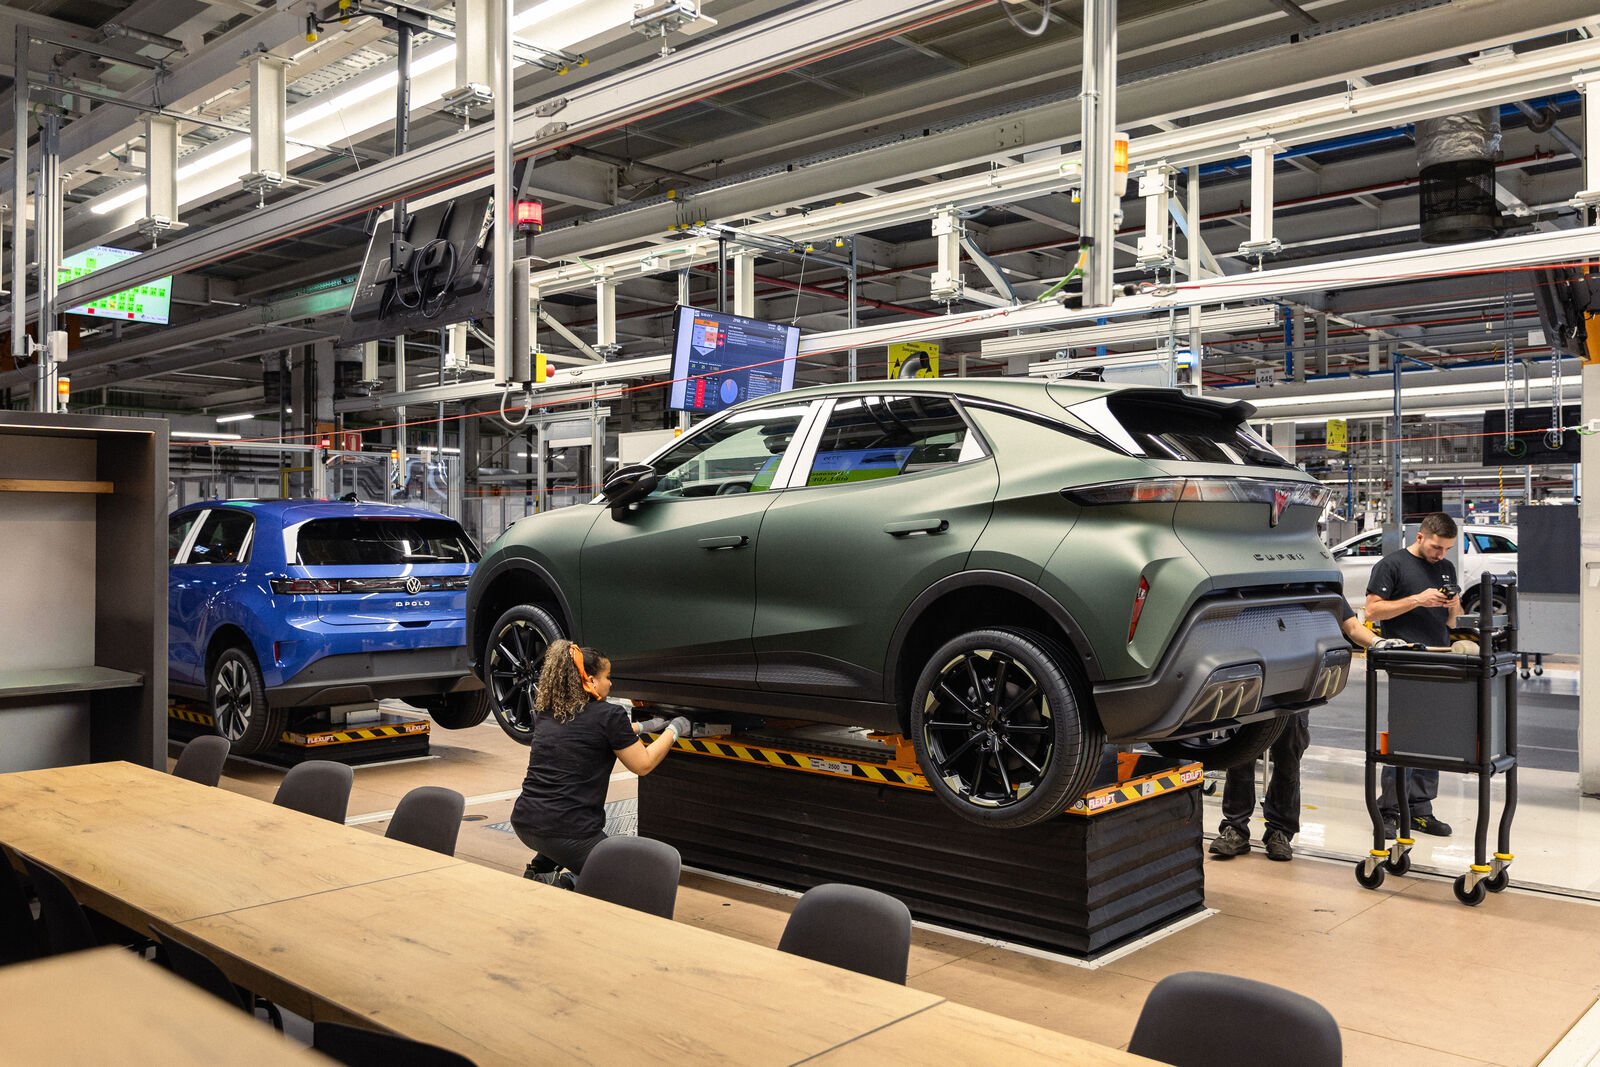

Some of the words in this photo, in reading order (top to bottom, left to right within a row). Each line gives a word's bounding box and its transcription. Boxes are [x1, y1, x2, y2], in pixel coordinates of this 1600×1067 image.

[1256, 375, 1273, 384] L445
[1145, 783, 1151, 794] 2
[1088, 793, 1116, 810] FLEXLIFT
